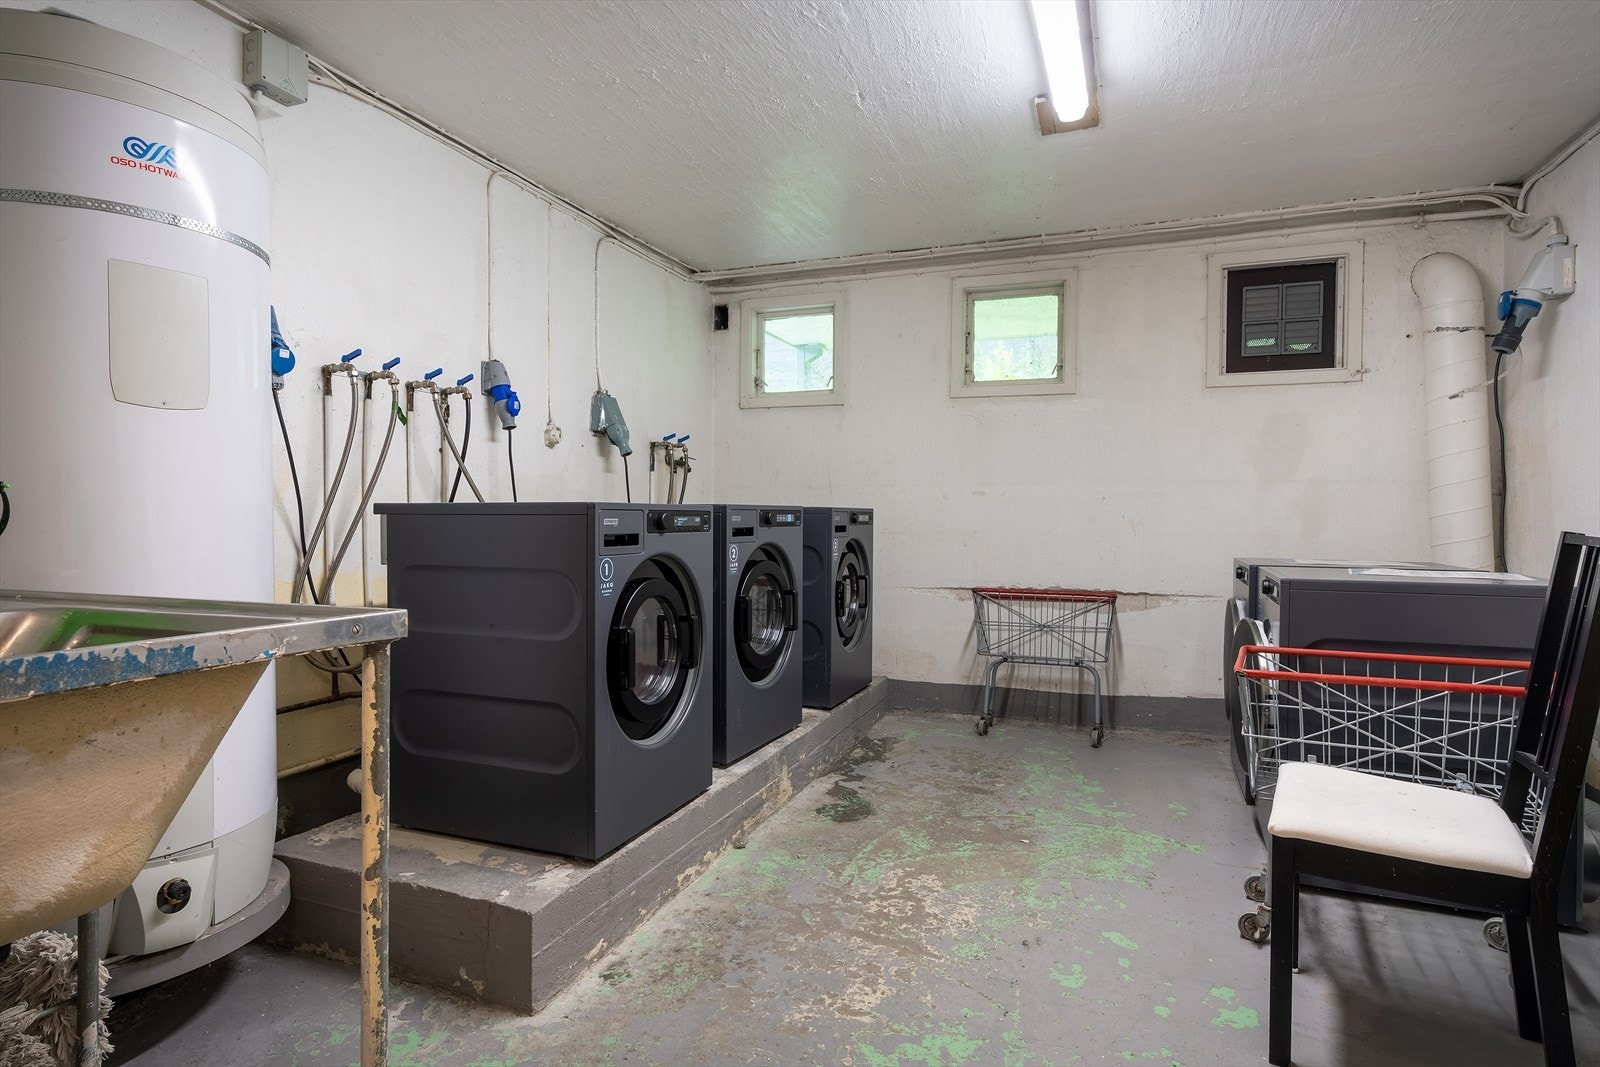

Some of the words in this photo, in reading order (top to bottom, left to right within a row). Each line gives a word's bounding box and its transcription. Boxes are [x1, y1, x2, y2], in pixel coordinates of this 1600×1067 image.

[110, 156, 136, 168] OSO
[139, 162, 183, 180] HOTWA
[732, 548, 736, 558] 2
[604, 564, 608, 576] 1
